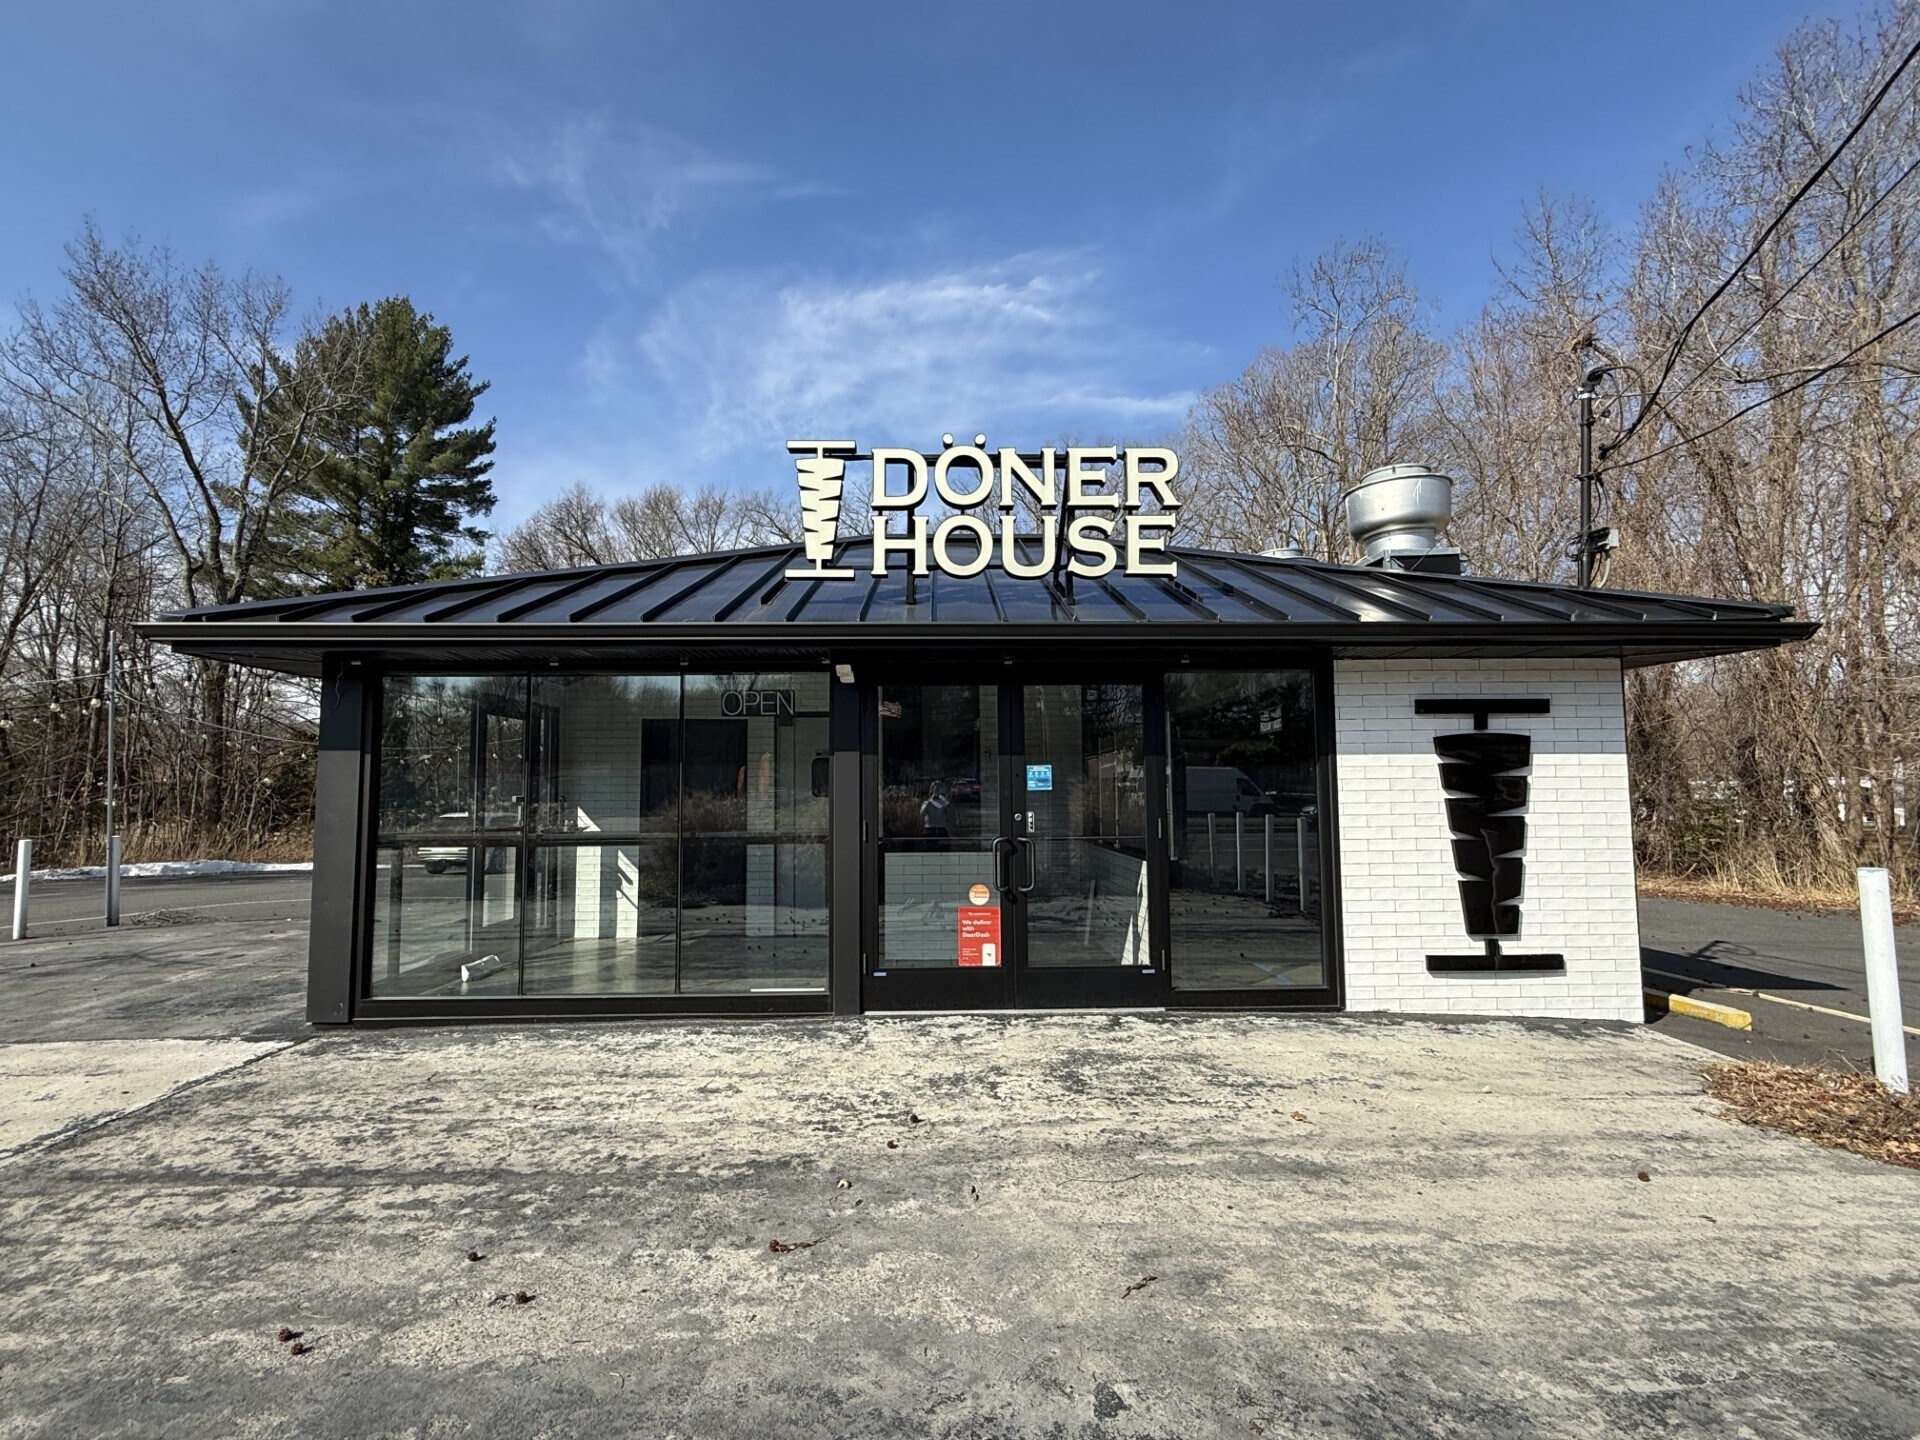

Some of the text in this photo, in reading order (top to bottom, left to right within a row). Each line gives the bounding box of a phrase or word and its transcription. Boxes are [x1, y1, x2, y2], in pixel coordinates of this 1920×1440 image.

[870, 432, 1182, 510] DÖNER
[870, 514, 1178, 580] HOUSE
[722, 690, 794, 716] OPEN
